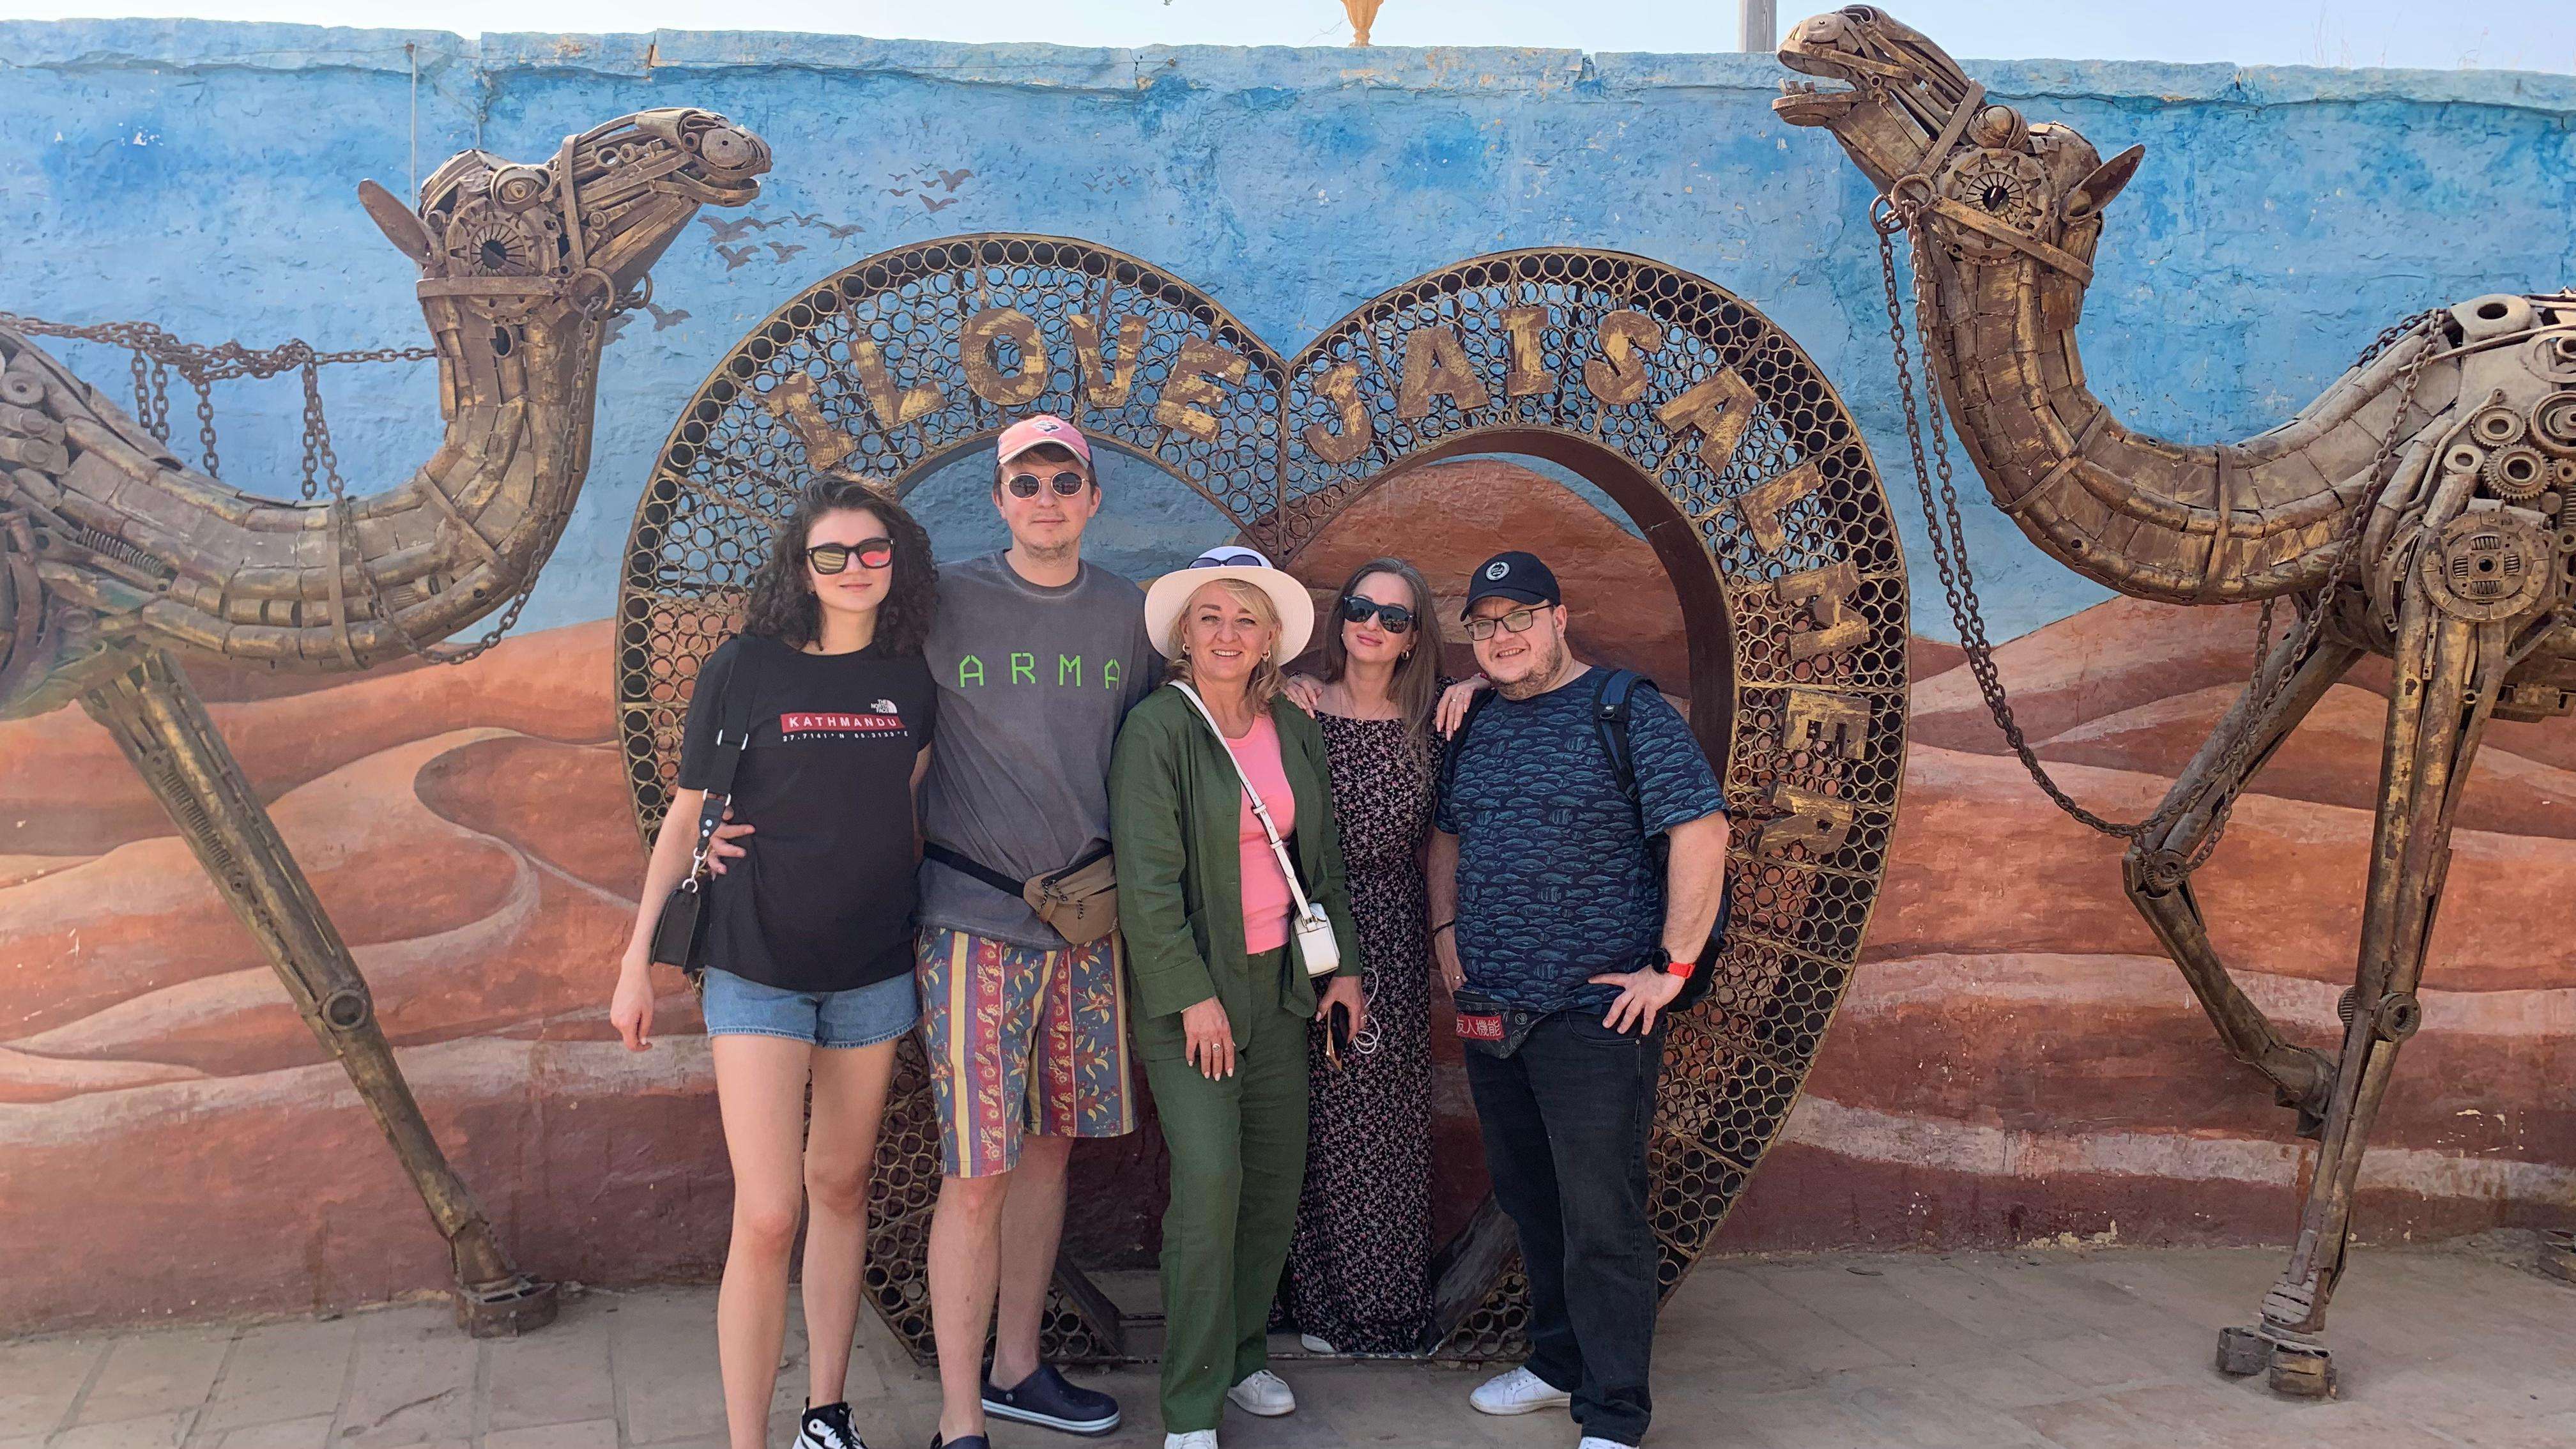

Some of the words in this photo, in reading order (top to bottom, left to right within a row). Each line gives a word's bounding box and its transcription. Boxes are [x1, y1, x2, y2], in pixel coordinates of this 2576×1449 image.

[769, 370, 854, 471] I
[847, 307, 1250, 444] LOVE
[1303, 306, 1871, 861] JAISALMER
[788, 716, 897, 728] KATHMANDU
